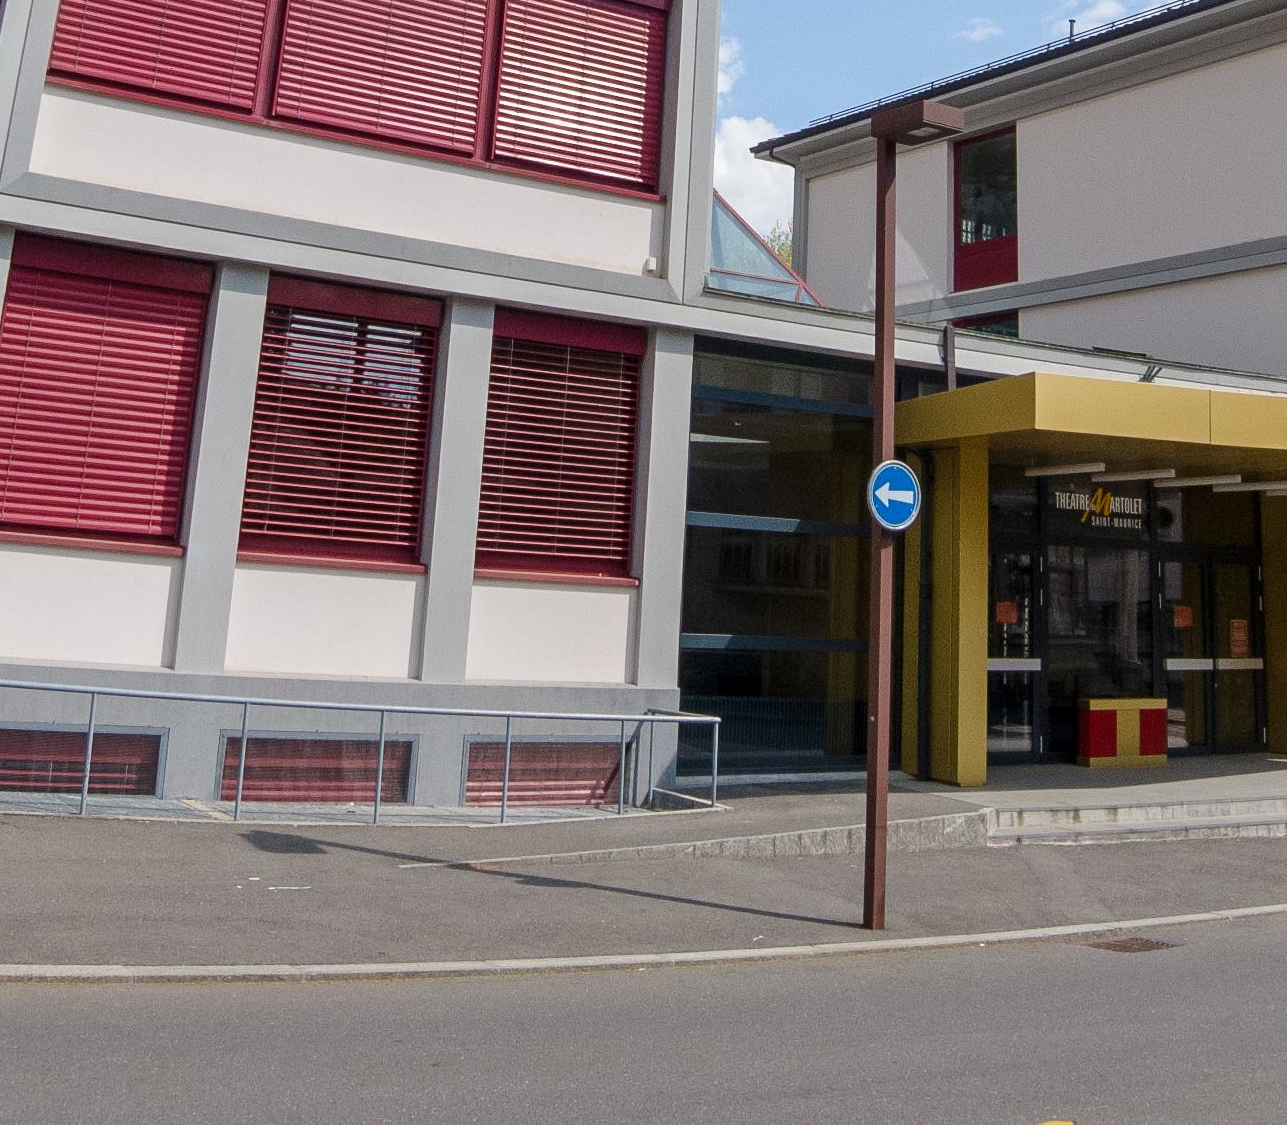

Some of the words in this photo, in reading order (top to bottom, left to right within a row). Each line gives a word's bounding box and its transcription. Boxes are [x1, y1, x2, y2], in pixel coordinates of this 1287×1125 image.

[1055, 492, 1090, 511] THEATRE
[1080, 487, 1142, 523] MARTOLET
[1091, 516, 1142, 529] SAINT-MAURICE
